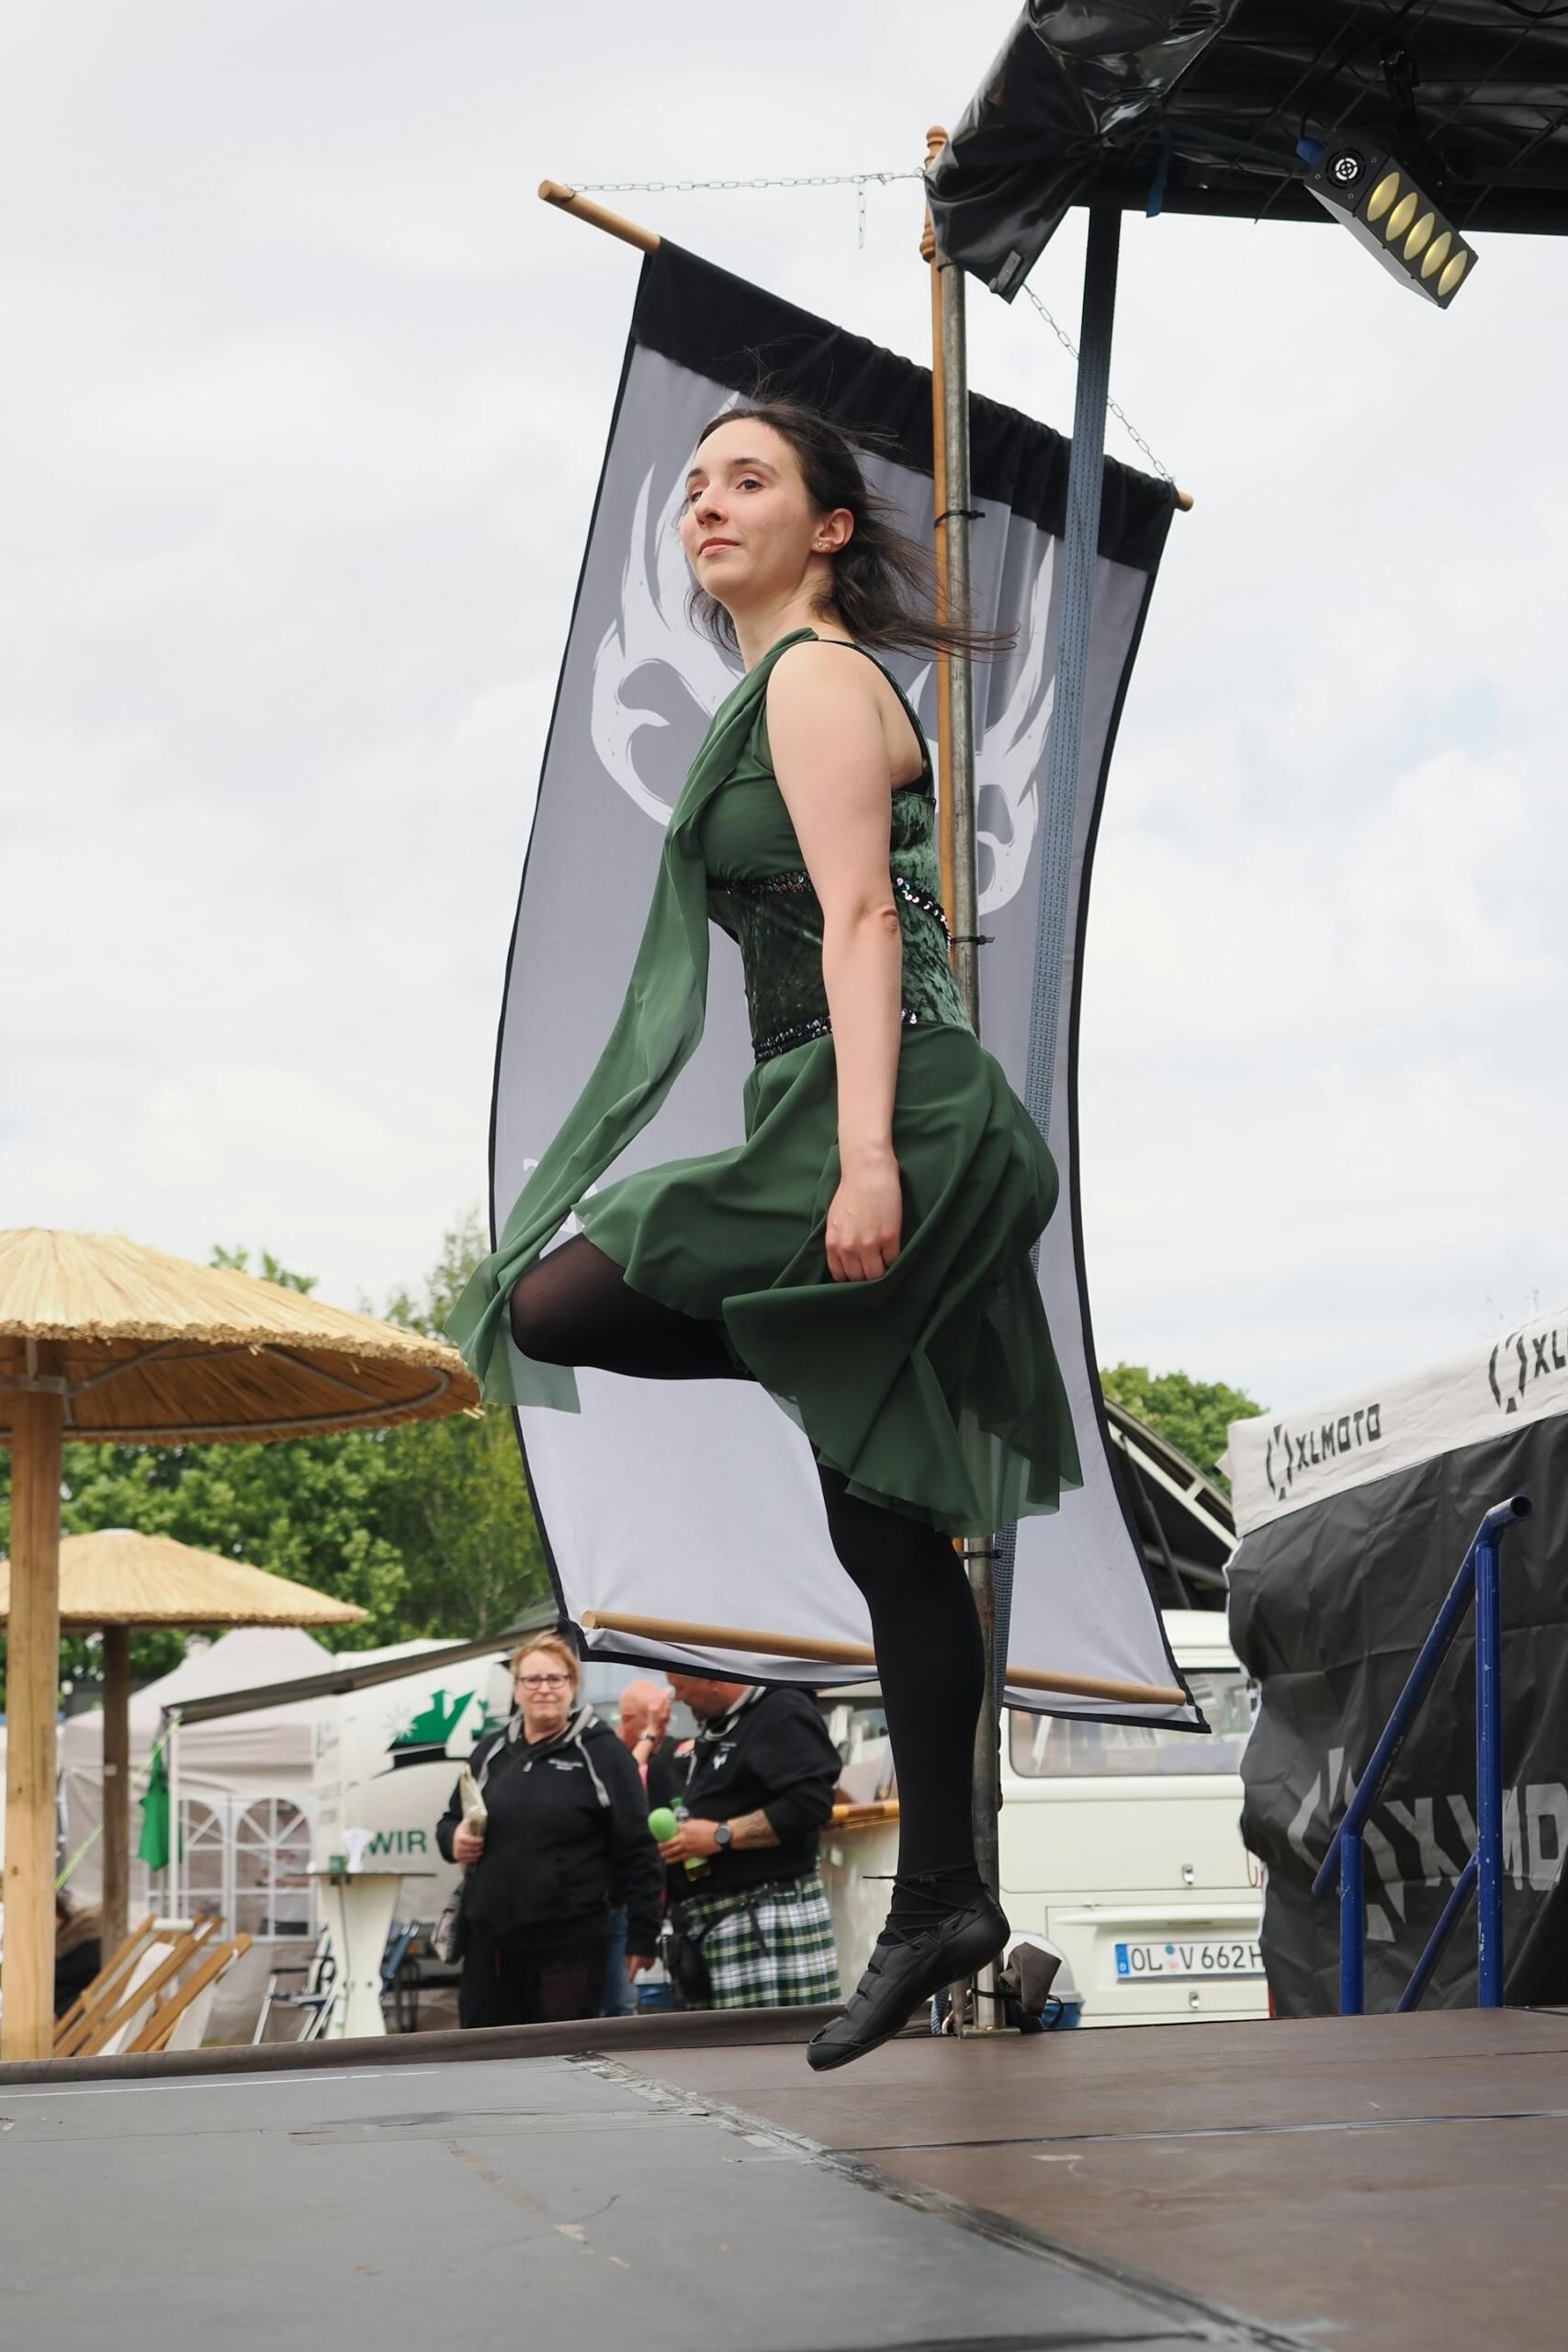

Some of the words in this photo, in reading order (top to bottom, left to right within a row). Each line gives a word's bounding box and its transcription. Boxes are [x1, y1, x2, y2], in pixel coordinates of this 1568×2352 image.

[1532, 1329, 1568, 1378] XL
[1296, 1404, 1381, 1471] XLMOTO
[369, 1830, 427, 1855] WIR
[1131, 1948, 1162, 1971] OL
[1179, 1947, 1193, 1969] V
